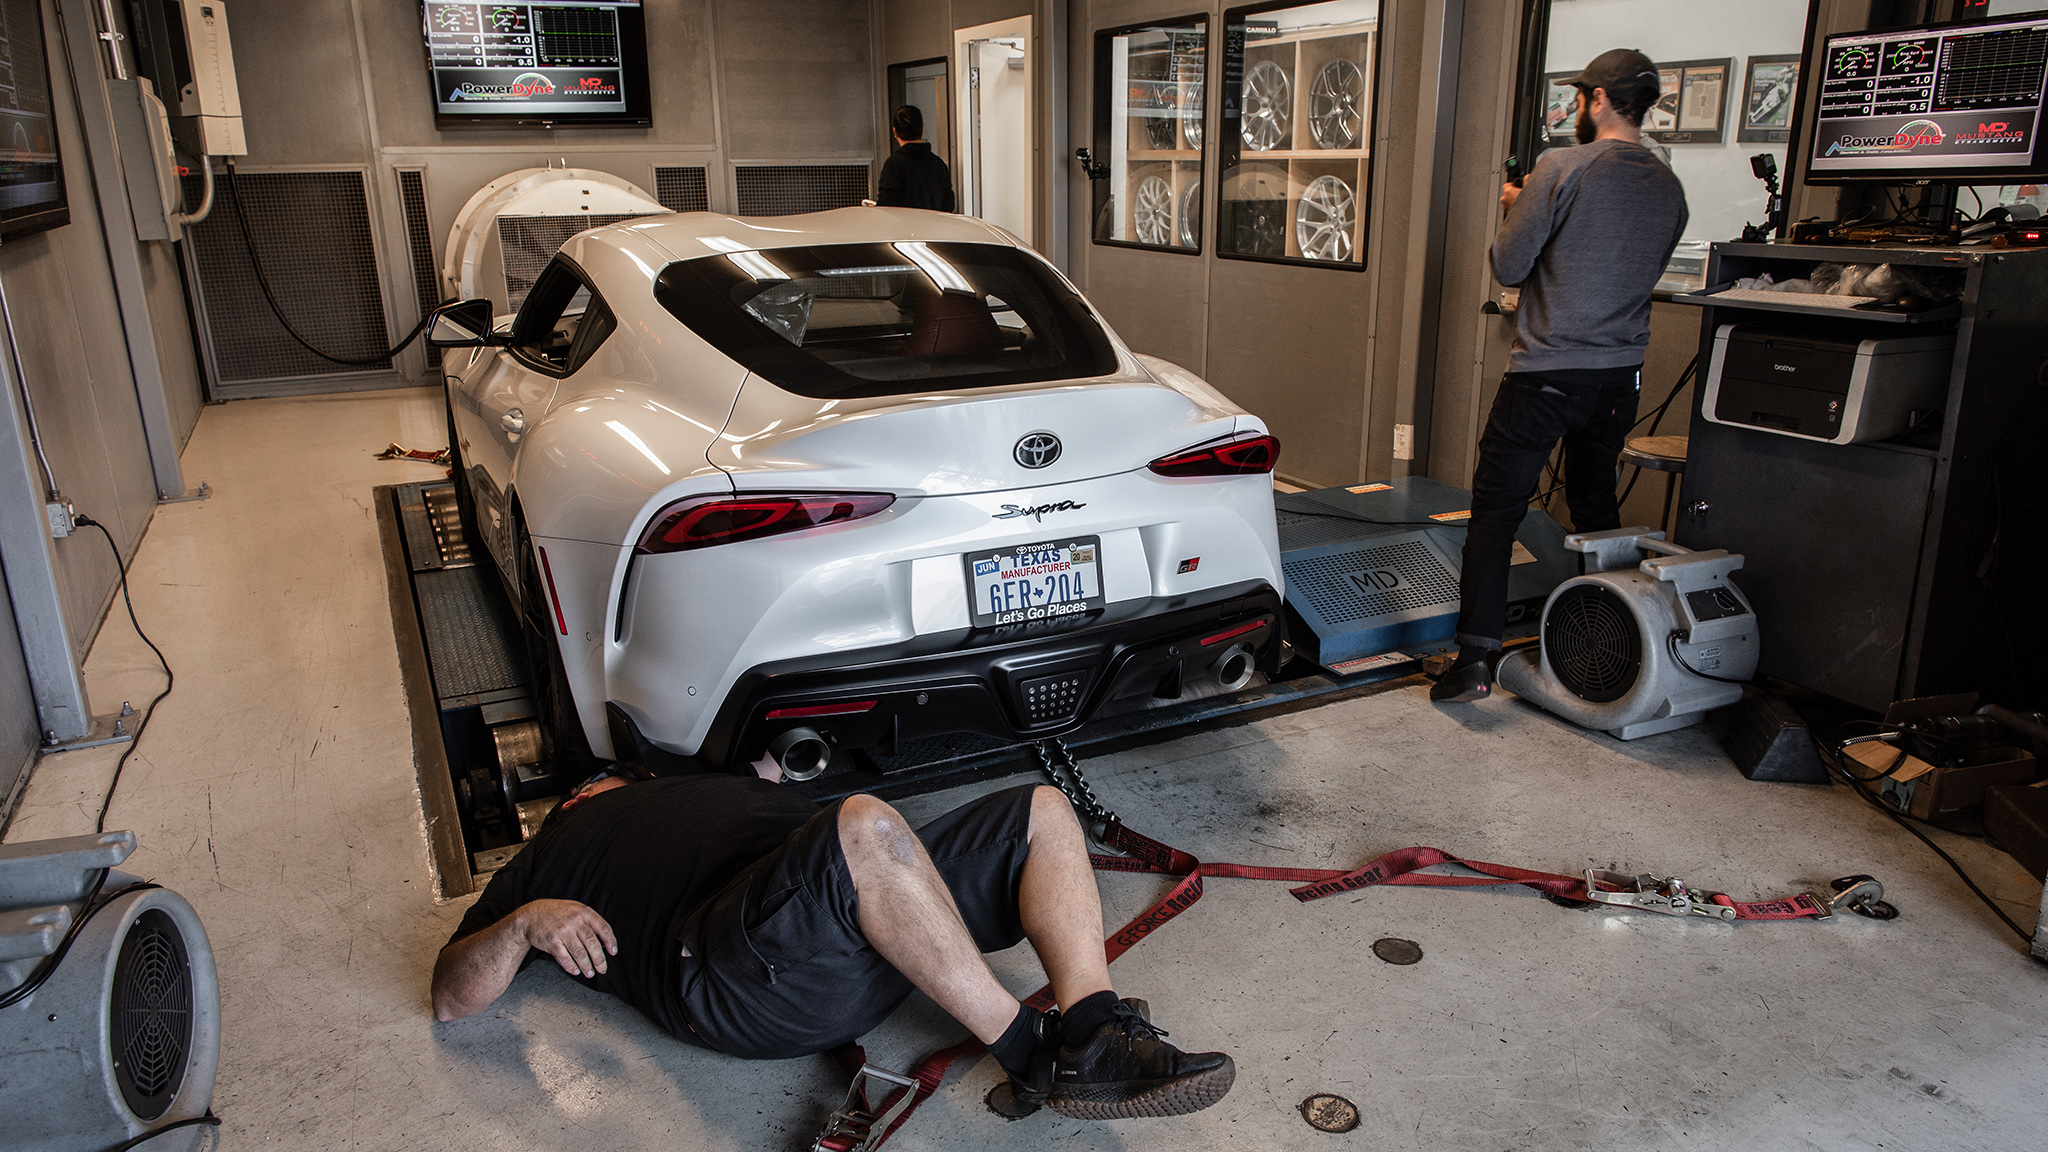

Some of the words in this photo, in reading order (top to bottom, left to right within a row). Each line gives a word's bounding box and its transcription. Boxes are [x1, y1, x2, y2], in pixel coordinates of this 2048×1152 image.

[472, 35, 480, 43] 0
[512, 36, 530, 44] -1.0
[473, 46, 481, 55] 0
[524, 47, 532, 55] 0
[475, 58, 482, 66] 0
[517, 58, 533, 66] 9.5
[579, 77, 602, 86] MD
[1866, 80, 1874, 88] 0
[1910, 75, 1931, 85] -1.0
[462, 81, 554, 97] PowerDyne
[1921, 89, 1929, 97] 0
[1864, 93, 1872, 101] 0
[1862, 106, 1870, 114] 0
[1909, 102, 1927, 112] 9.5
[1978, 122, 2008, 133] MD
[1955, 131, 2024, 139] MUSTANG
[1841, 132, 1943, 149] PowerDyne
[1774, 364, 1797, 373] brother
[991, 499, 1087, 523] Supra
[1027, 543, 1056, 553] TOYOTA
[1010, 549, 1062, 568] TEXAS
[1072, 552, 1081, 562] 20
[977, 562, 996, 574] JUN
[1001, 561, 1071, 580] MANUFACTURER
[1180, 562, 1197, 572] GR
[1349, 570, 1399, 593] MD
[995, 610, 1024, 625] Let's
[1027, 607, 1045, 620] Go
[1047, 602, 1087, 617] Places
[1341, 866, 1383, 888] Gear
[1116, 905, 1176, 947] G-FORCE
